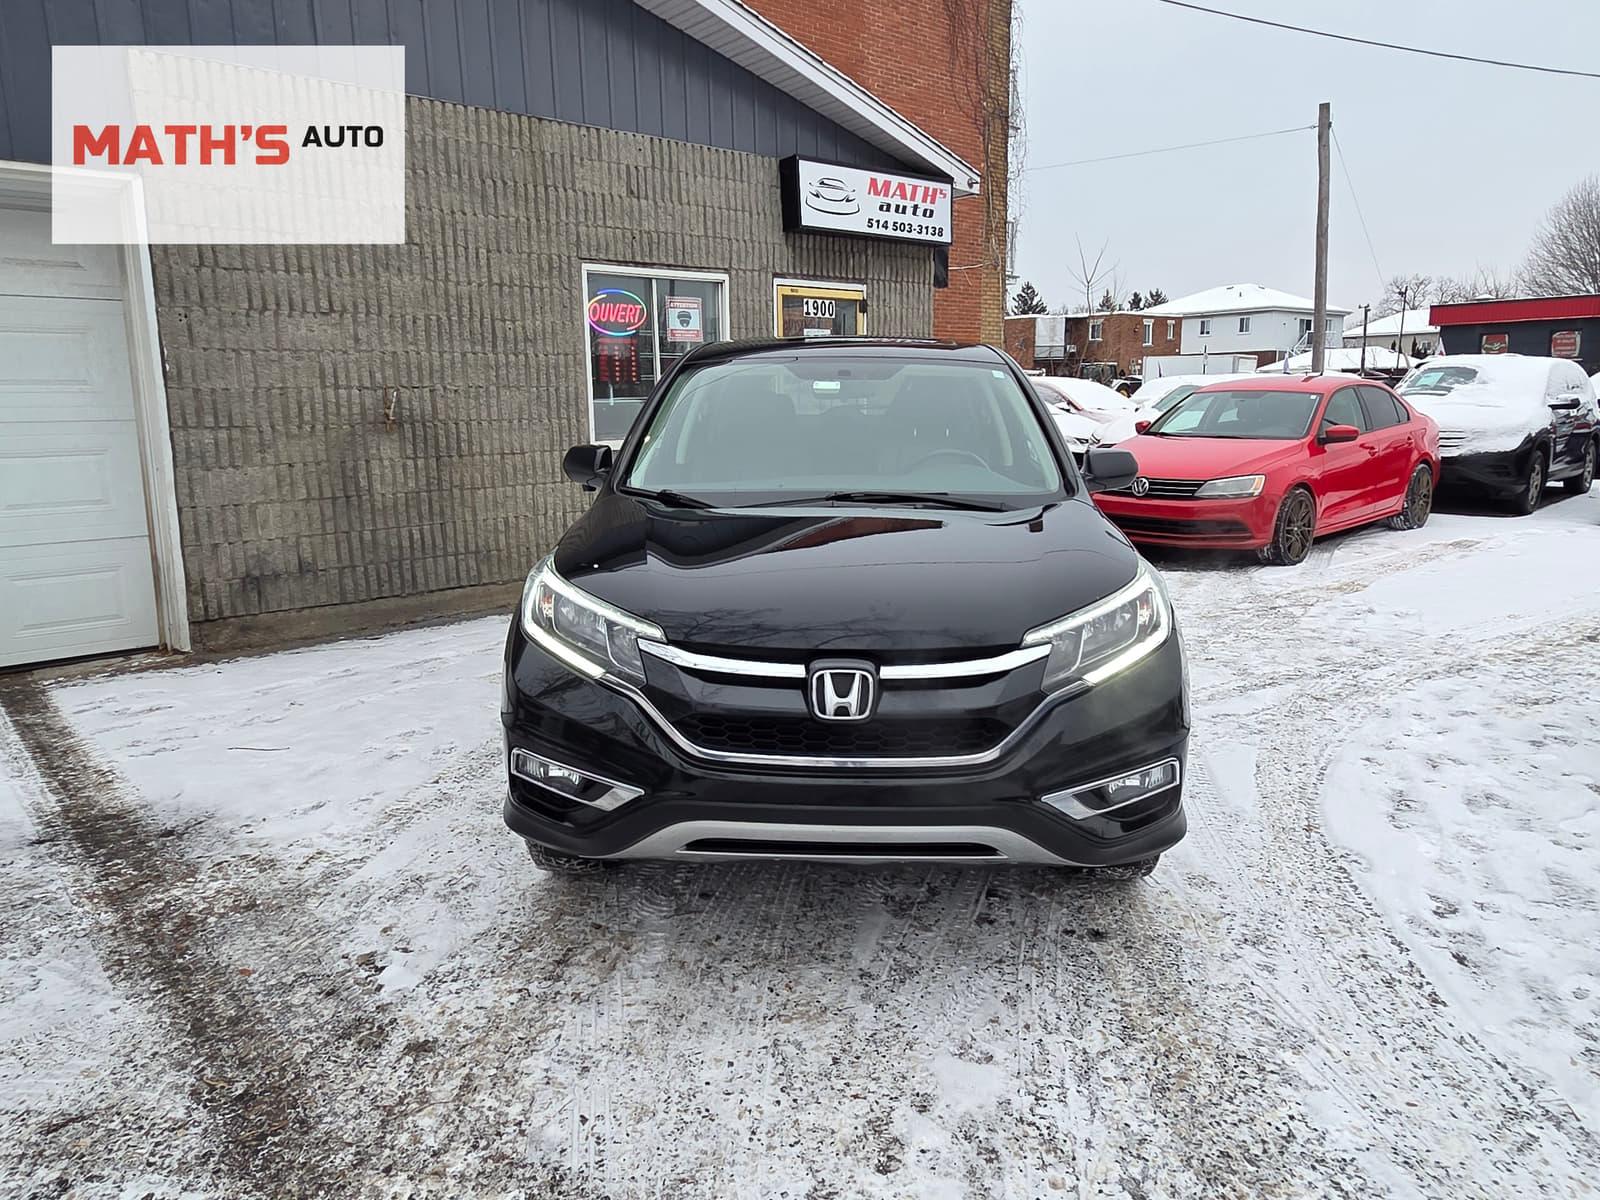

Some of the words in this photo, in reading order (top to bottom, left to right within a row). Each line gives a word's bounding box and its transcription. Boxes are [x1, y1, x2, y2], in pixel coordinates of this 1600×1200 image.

[879, 202, 935, 219] auto
[866, 218, 889, 231] 514
[892, 221, 944, 237] 503-3138
[589, 302, 642, 324] OUVERT
[804, 299, 834, 317] 1900
